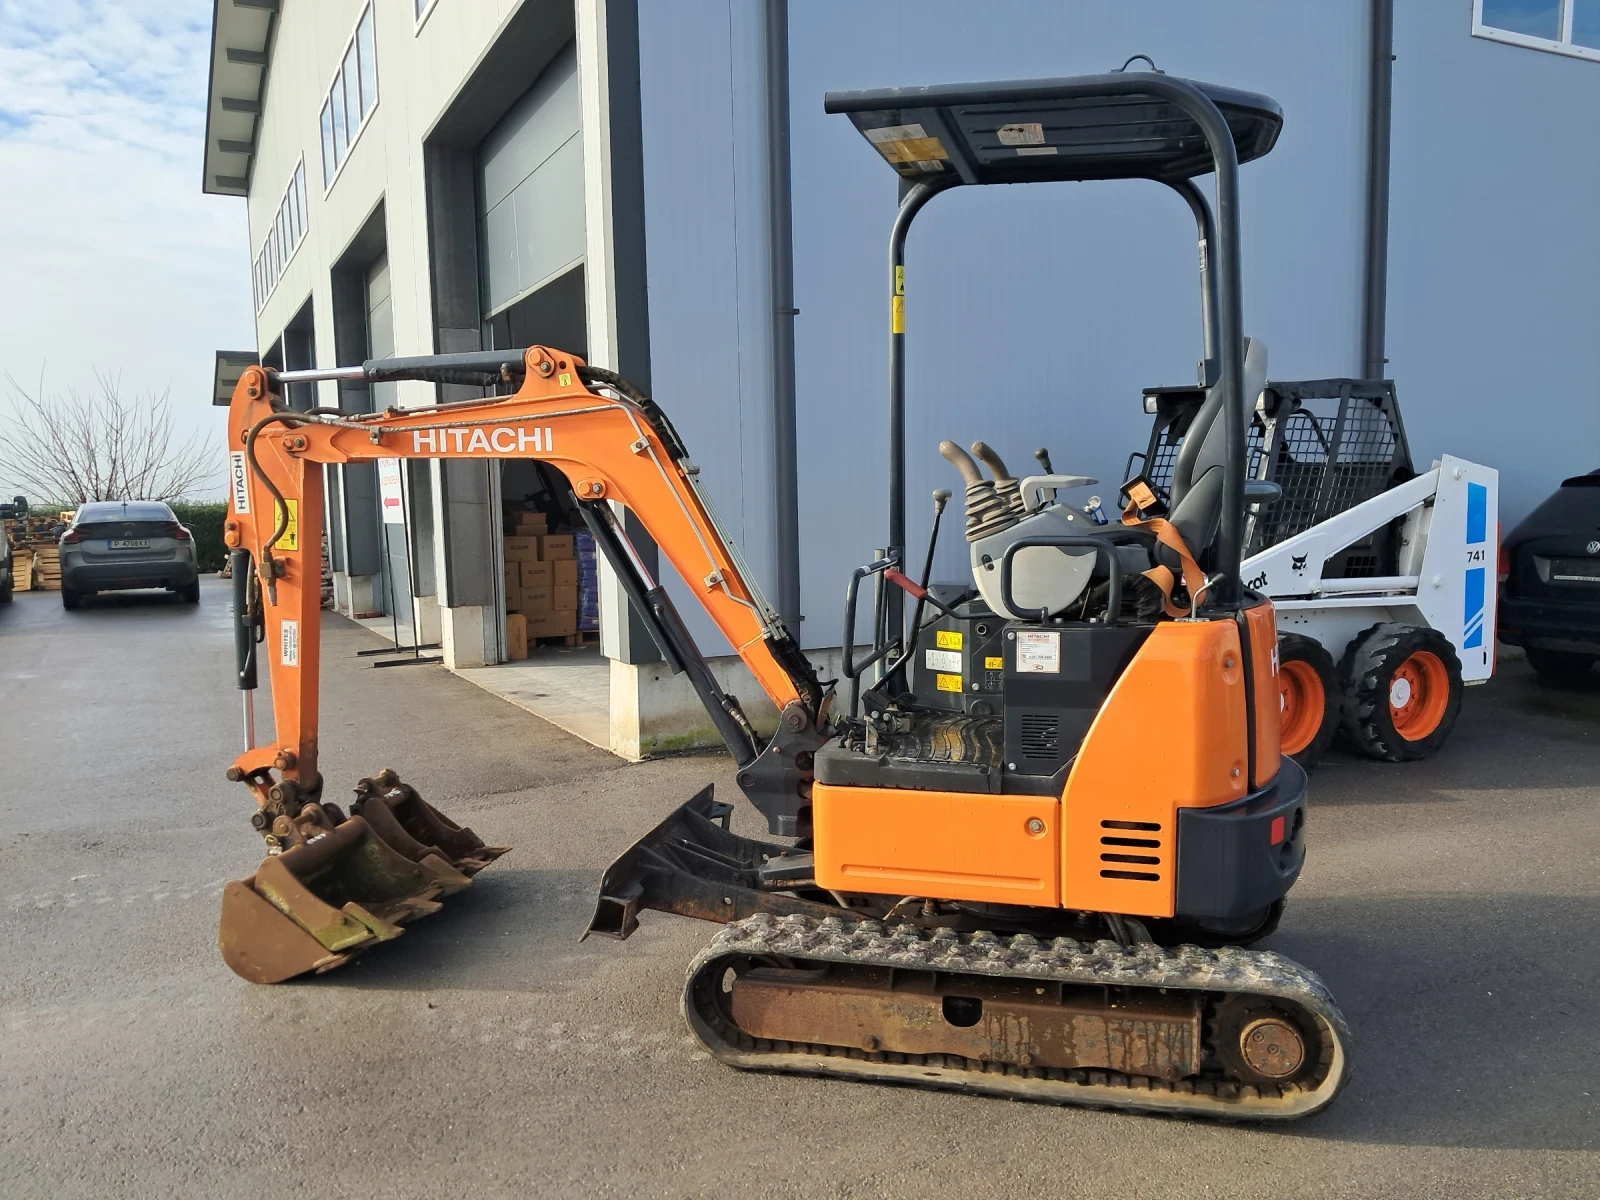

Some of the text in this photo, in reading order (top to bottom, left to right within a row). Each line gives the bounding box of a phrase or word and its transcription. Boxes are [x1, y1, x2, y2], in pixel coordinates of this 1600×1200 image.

[413, 427, 553, 453] HITACHI
[231, 454, 246, 510] HITACHI
[1467, 550, 1485, 563] 741
[1247, 570, 1269, 591] cat
